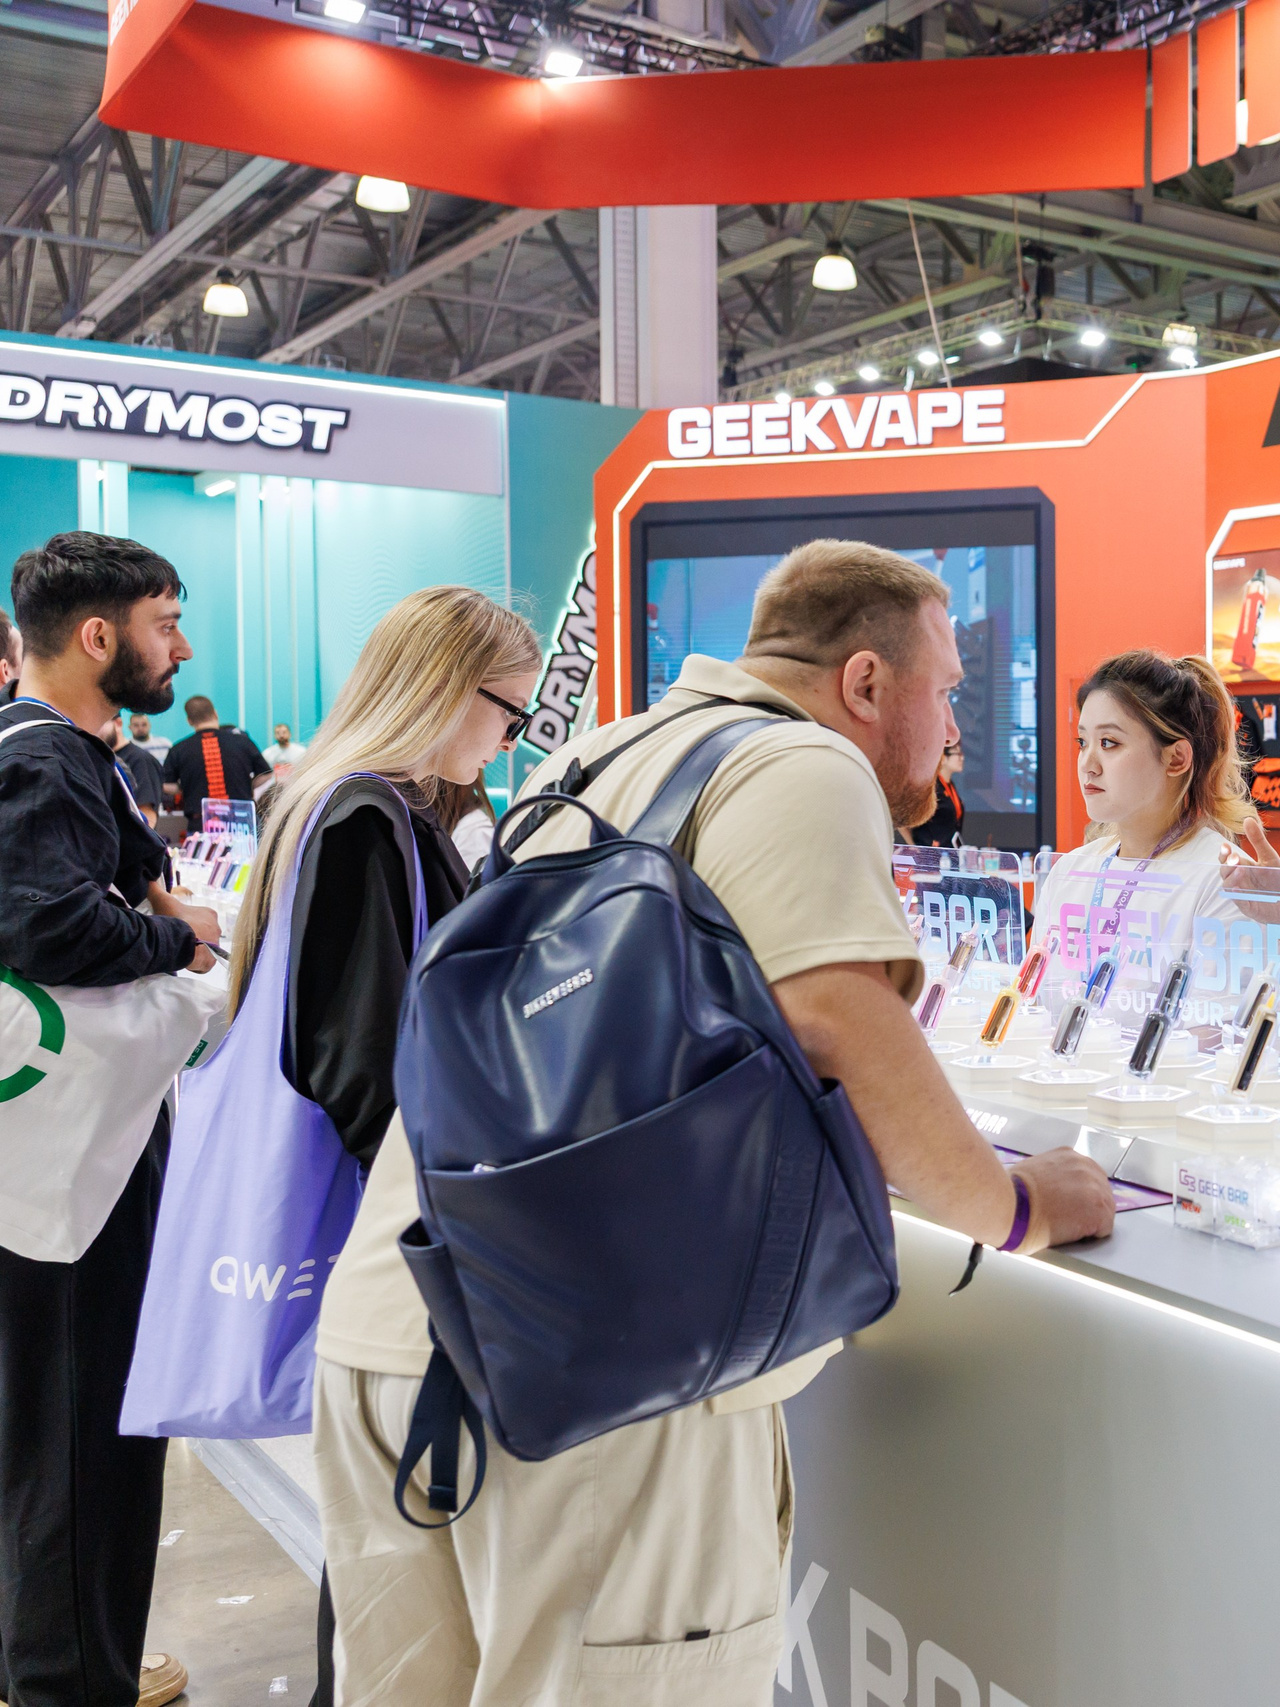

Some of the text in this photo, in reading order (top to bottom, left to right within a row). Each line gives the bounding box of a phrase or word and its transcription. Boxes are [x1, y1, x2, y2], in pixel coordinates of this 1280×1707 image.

[0, 373, 348, 452] DRYMOST
[667, 389, 1006, 459] GEEKVAPE
[523, 551, 597, 755] DRYMO
[922, 890, 1000, 963] BAR
[1060, 902, 1182, 985] GEEK
[1181, 1200, 1201, 1214] NEW
[1198, 1179, 1225, 1199] GEEK
[1227, 1187, 1249, 1206] BAR
[210, 1255, 339, 1302] QWE
